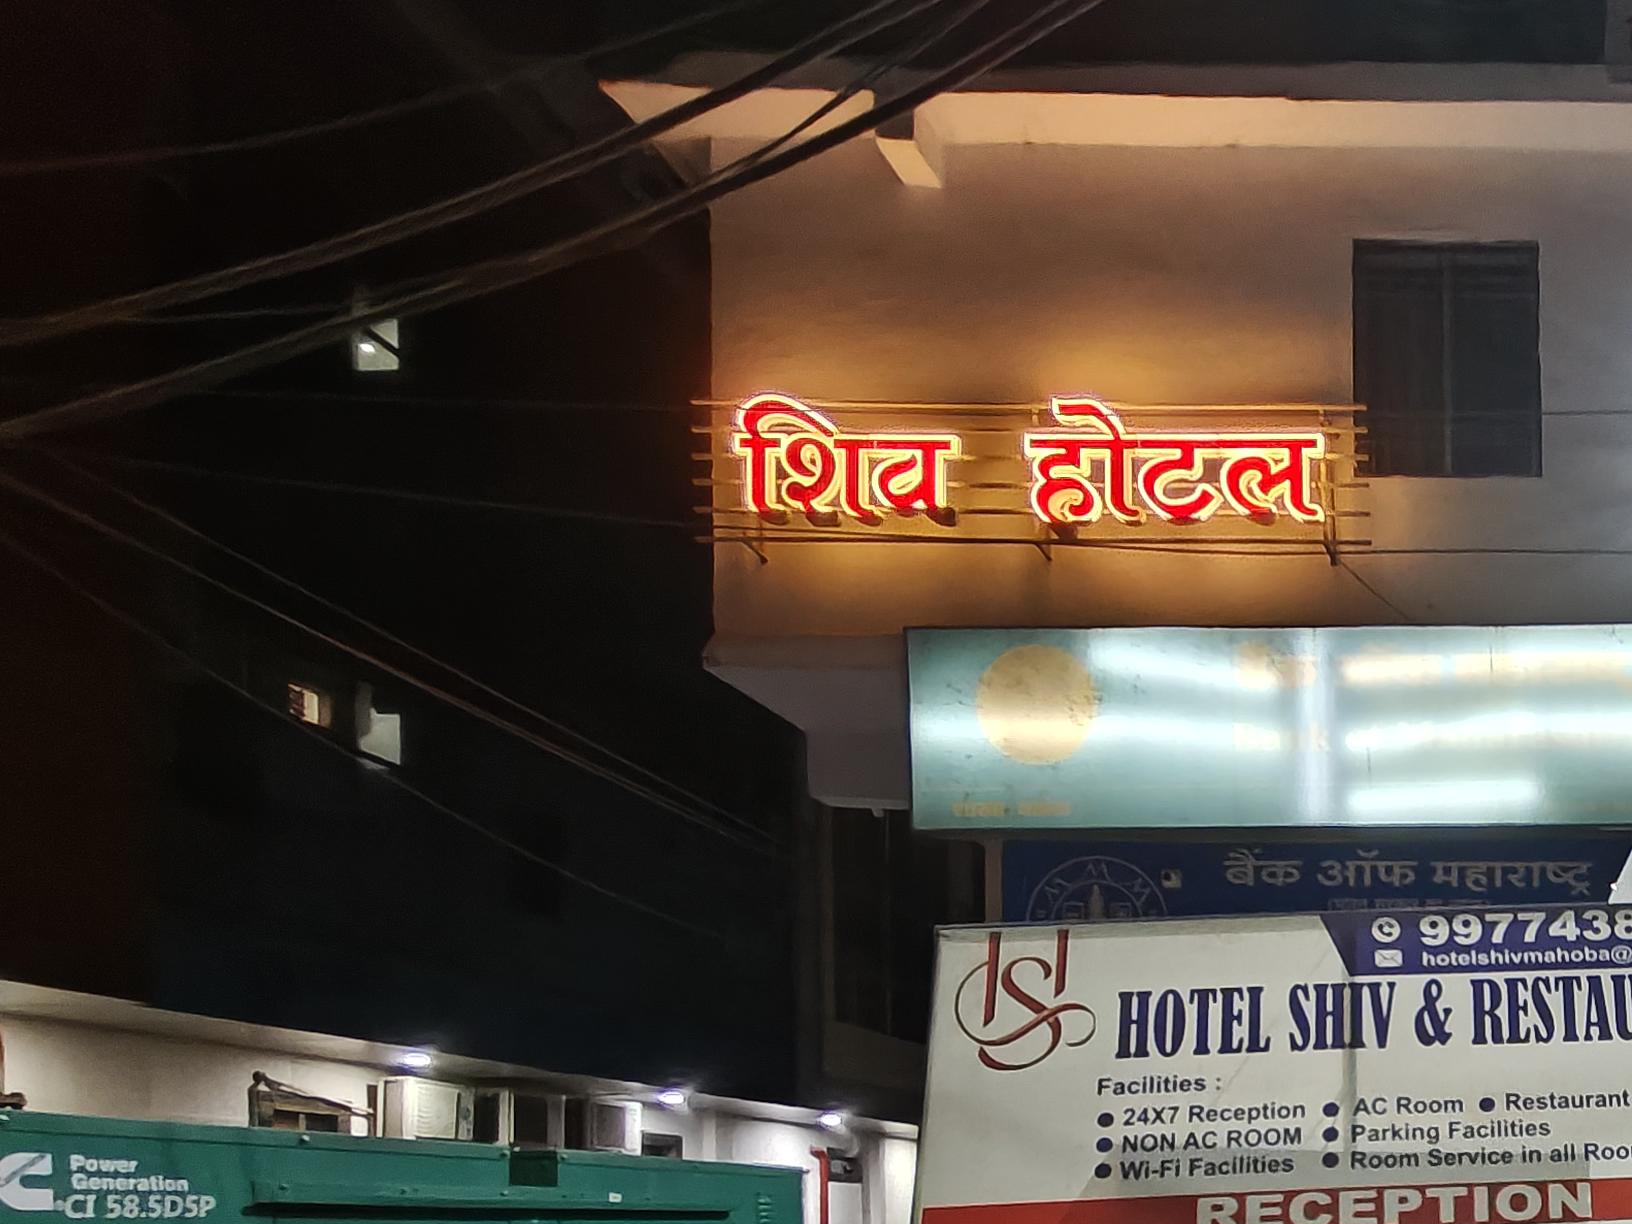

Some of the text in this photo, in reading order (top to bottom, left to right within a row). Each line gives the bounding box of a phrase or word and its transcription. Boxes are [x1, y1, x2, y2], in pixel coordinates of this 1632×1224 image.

[735, 394, 1325, 524] शिव होटल
[1224, 848, 1594, 895] बैंक ऑफ महाराष्ट्र
[1115, 985, 1271, 1060] HOTEL
[1289, 981, 1396, 1052] SHIV
[1414, 978, 1453, 1047] &
[1097, 1075, 1207, 1096] Facilities
[1353, 1096, 1464, 1116] AC Room
[1505, 1089, 1631, 1111] Restaurant
[1123, 1102, 1306, 1126] 24X7 Reception
[1122, 1127, 1302, 1153] NON AC ROOM
[1351, 1119, 1551, 1145] Parking Facilities
[70, 1154, 138, 1172] Power
[1120, 1155, 1295, 1180] Wi-Fi Facilities
[1351, 1151, 1419, 1170] Room
[1427, 1147, 1513, 1167] Service
[1522, 1145, 1542, 1163] in
[1549, 1144, 1576, 1163] all
[71, 1173, 189, 1191] Generation
